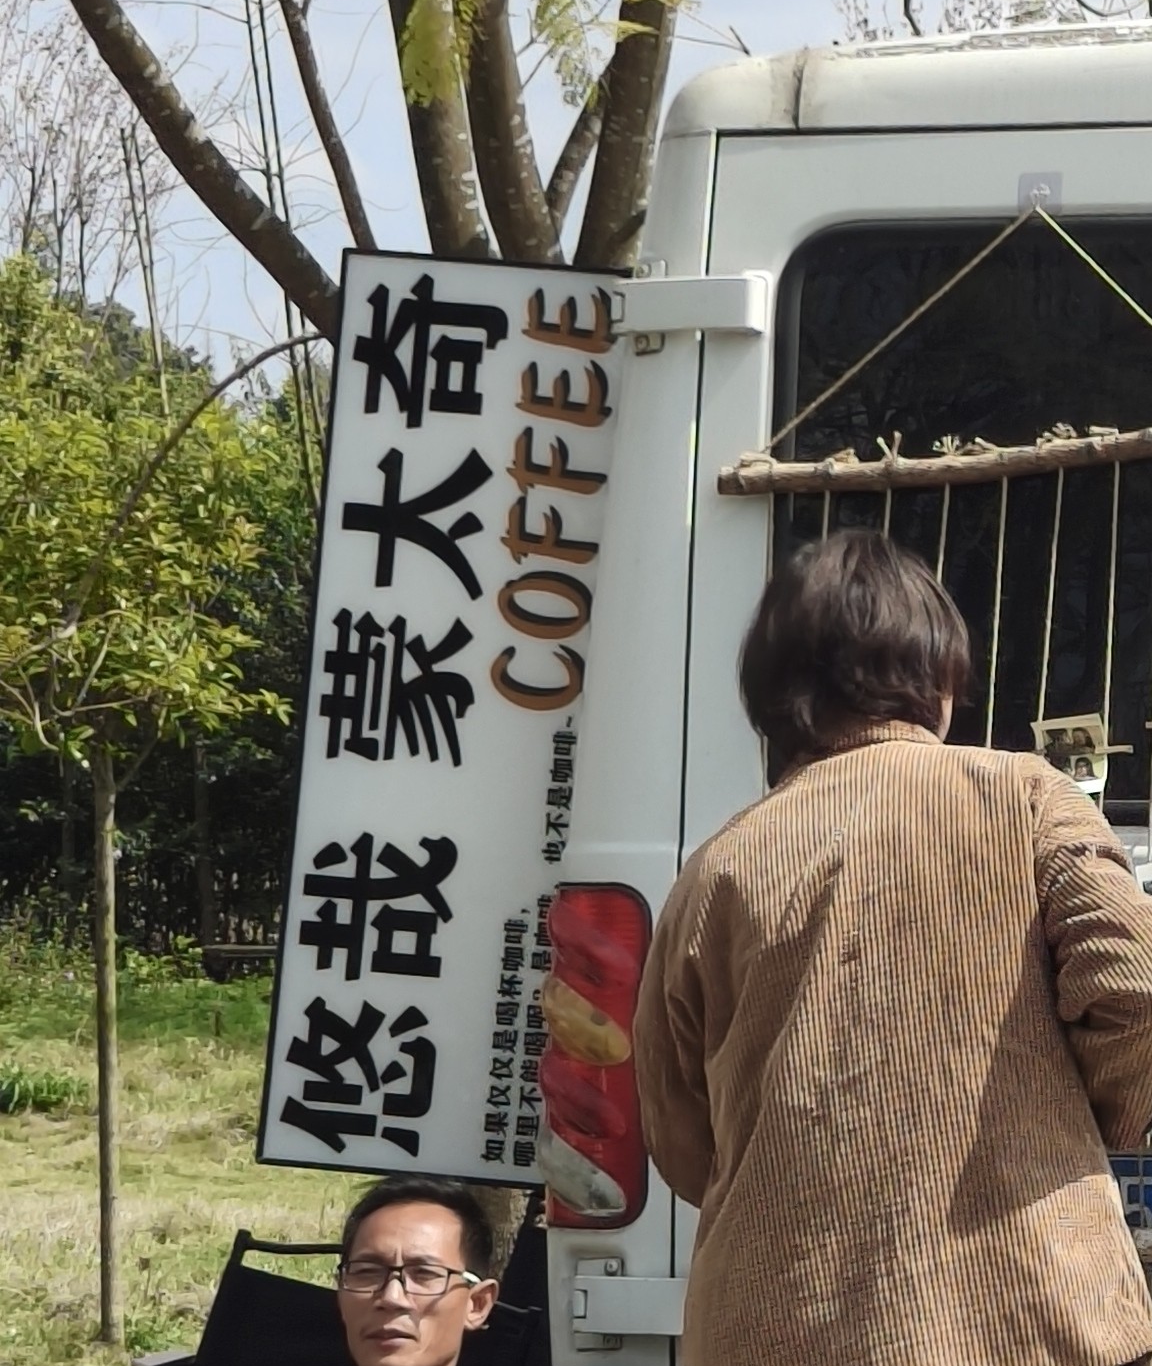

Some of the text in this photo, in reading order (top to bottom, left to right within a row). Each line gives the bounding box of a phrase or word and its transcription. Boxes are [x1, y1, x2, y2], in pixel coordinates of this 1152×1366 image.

[279, 273, 509, 1157] 悠哉蒙太奇
[489, 285, 618, 712] COFFEE
